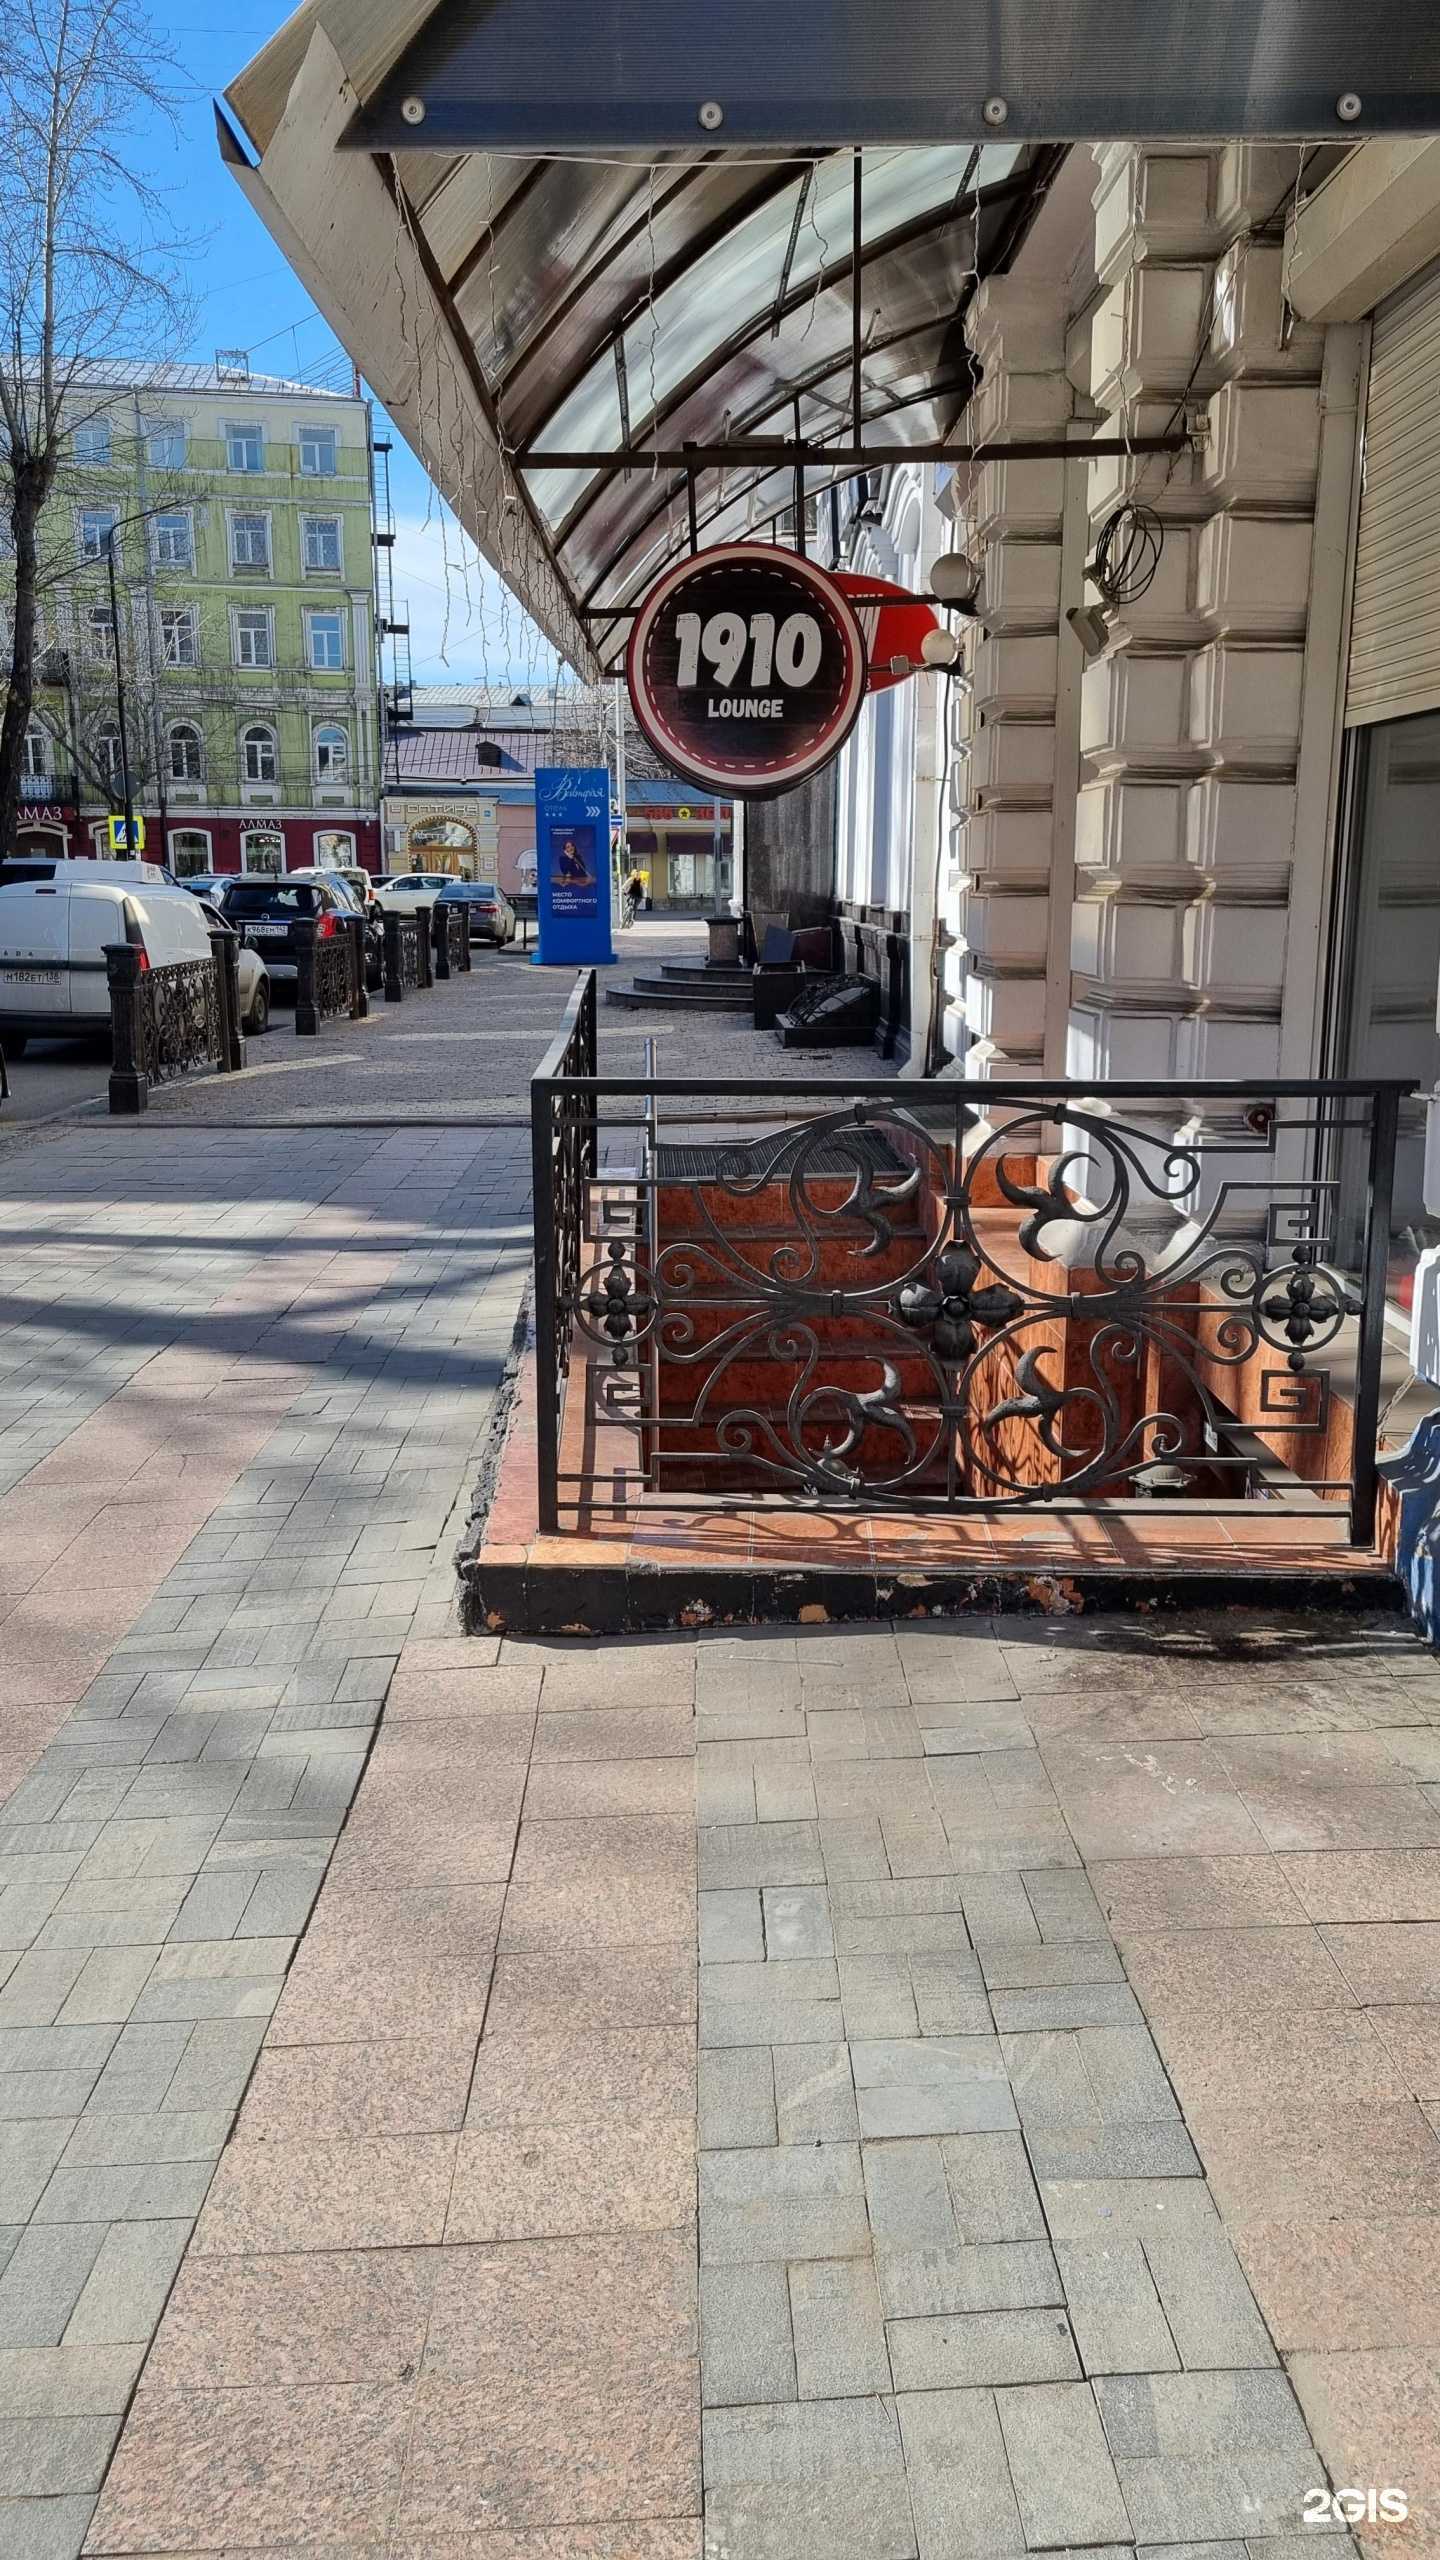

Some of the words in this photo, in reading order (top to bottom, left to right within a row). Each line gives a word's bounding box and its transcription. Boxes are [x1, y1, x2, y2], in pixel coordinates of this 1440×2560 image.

[675, 612, 822, 688] 1910
[707, 698, 784, 718] LOUNGE
[239, 819, 282, 830] АЛМАЗ
